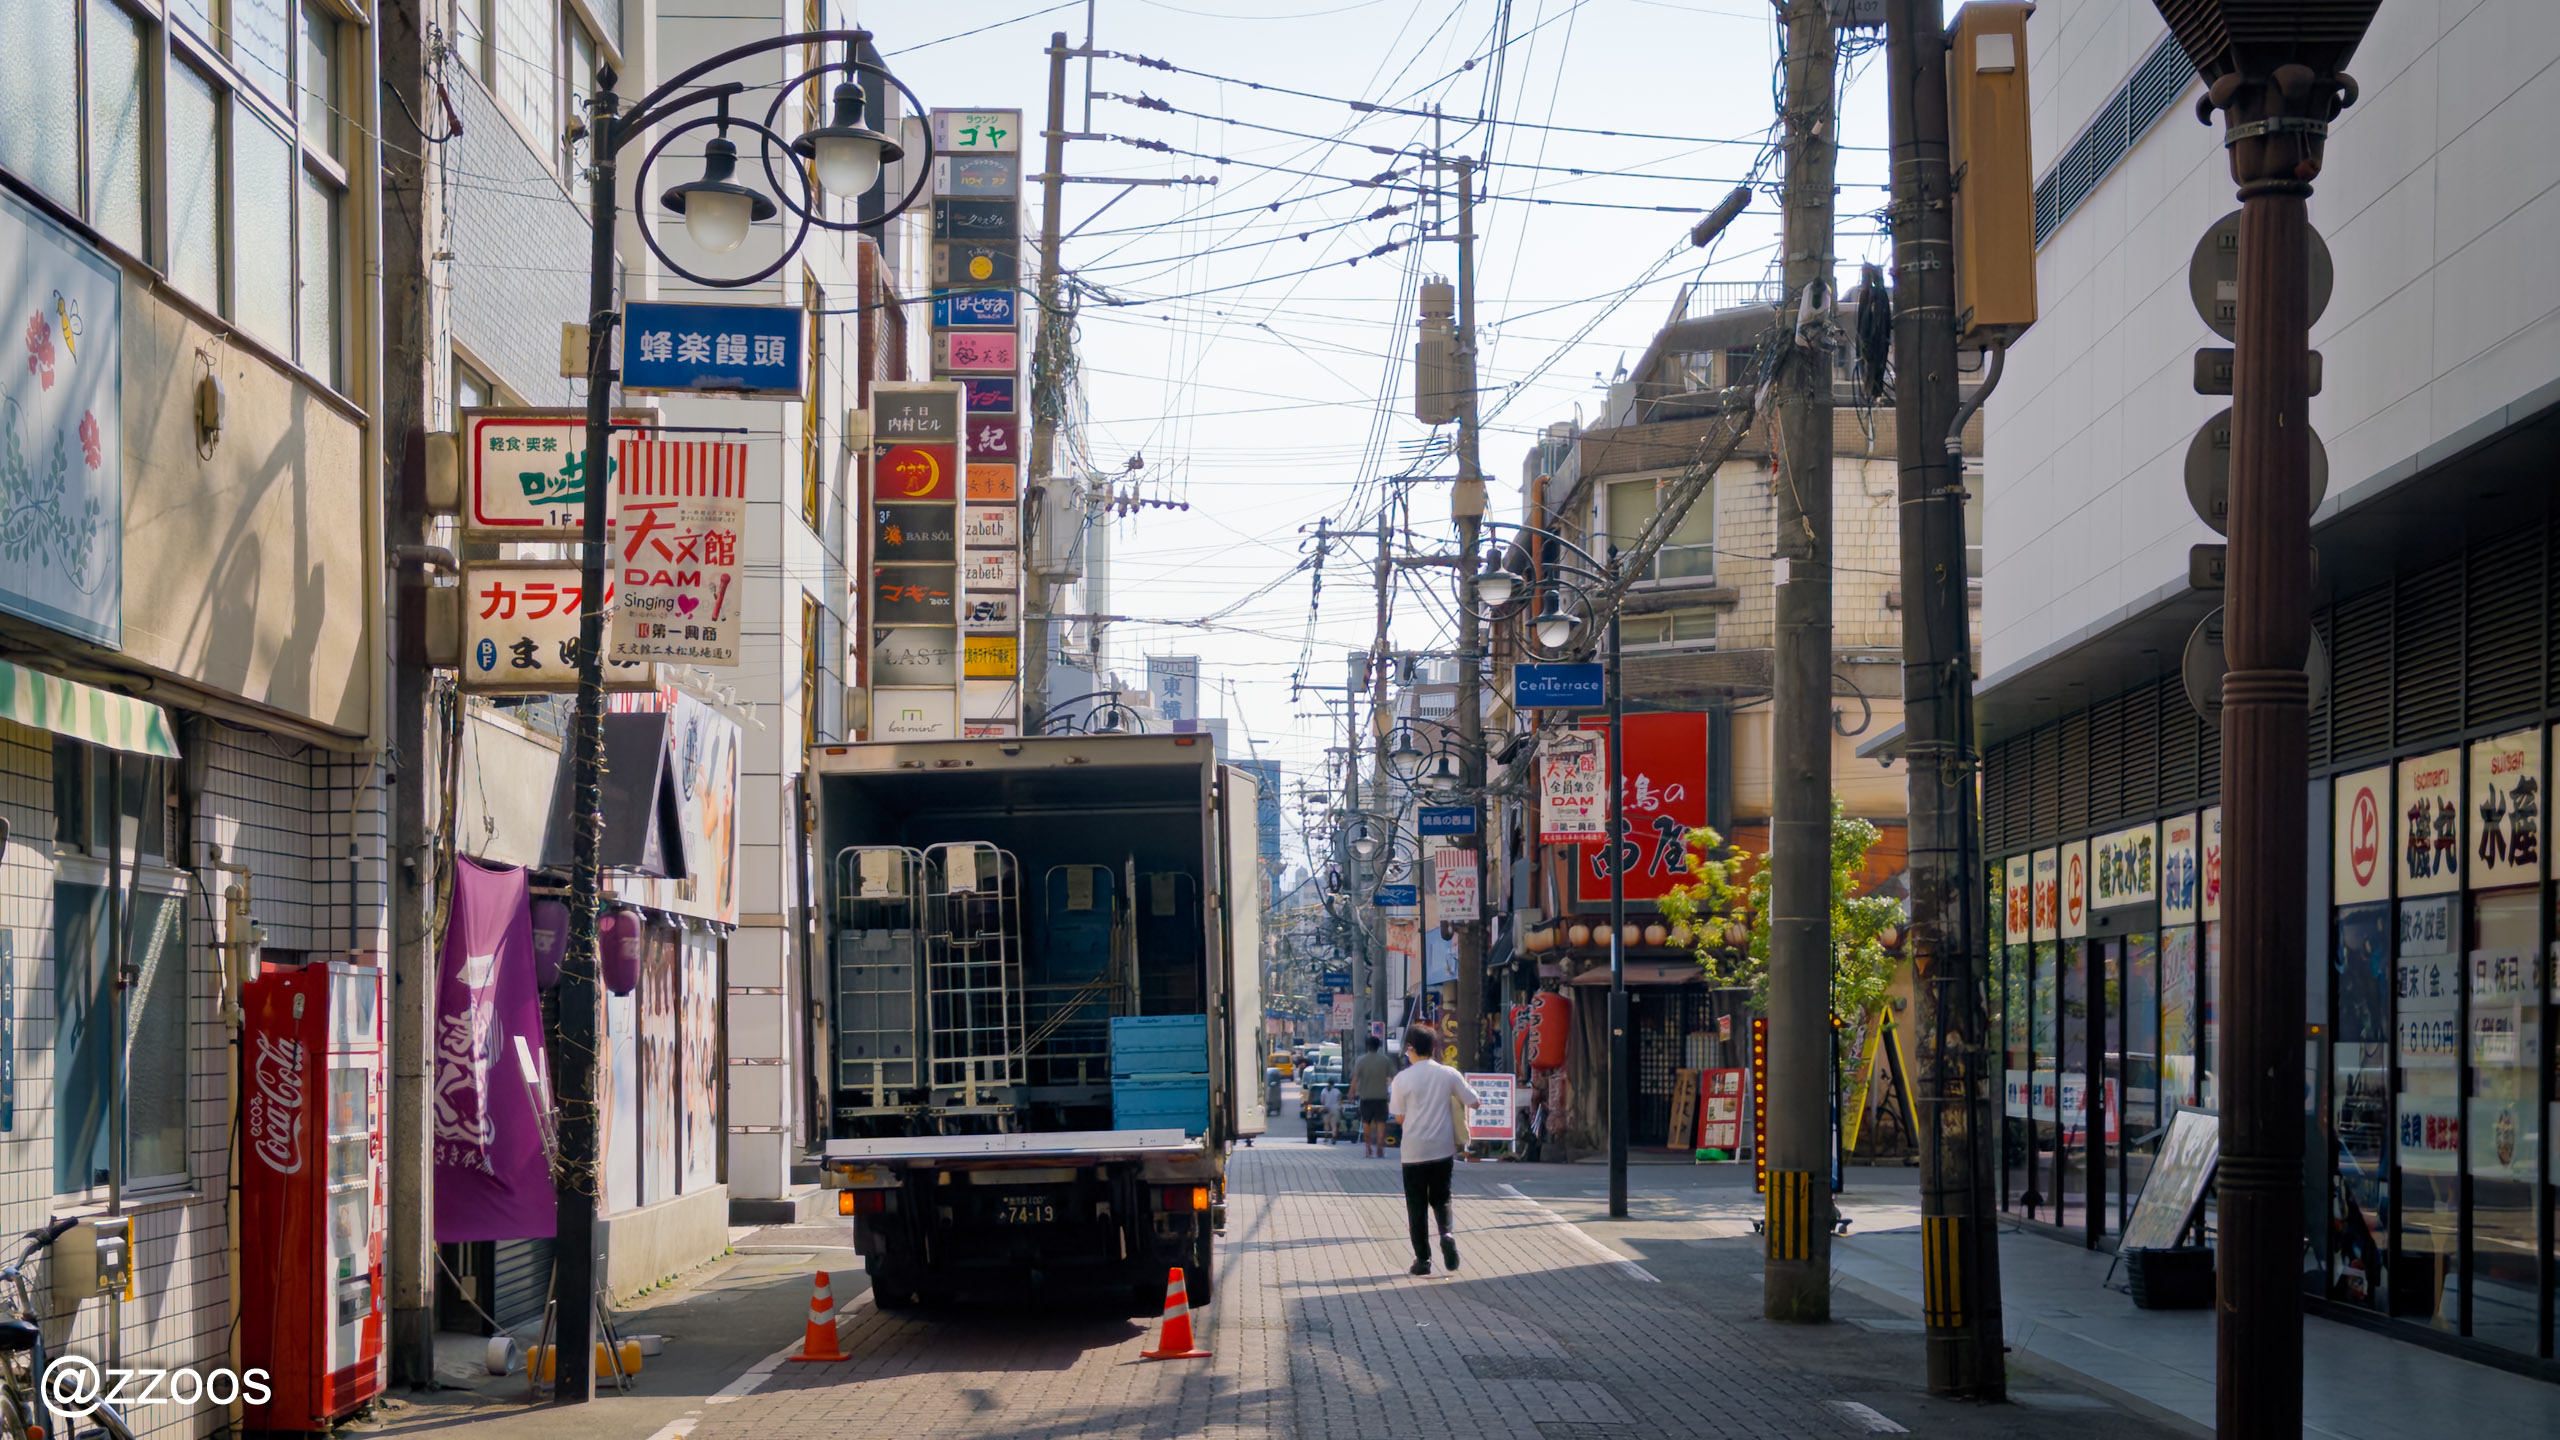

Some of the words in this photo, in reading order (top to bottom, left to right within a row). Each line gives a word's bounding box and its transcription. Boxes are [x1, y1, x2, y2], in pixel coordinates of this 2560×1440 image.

[958, 124, 1007, 149] ゴヤ
[640, 330, 786, 367] 蜂楽饅頭
[903, 406, 928, 416] 千日
[888, 418, 941, 432] 内村ビル
[550, 510, 572, 526] 1F
[880, 510, 890, 523] 3F
[624, 502, 737, 567] 天文館
[906, 532, 930, 541] BAR
[966, 521, 1003, 536] zabeth
[624, 568, 701, 587] DAM
[966, 564, 1003, 580] zabeth
[624, 591, 675, 613] Singing
[653, 623, 717, 641] 第一興商
[884, 648, 949, 665] LAST
[1151, 662, 1193, 673] HOTEL
[1547, 755, 1595, 779] 天文館
[2414, 767, 2449, 791] isomaru
[2491, 750, 2525, 775] suisan
[1552, 797, 1594, 806] DAM
[2407, 795, 2457, 879] 磯丸
[2478, 775, 2538, 870] 水産
[2099, 832, 2152, 899] 磯丸水産
[2400, 906, 2446, 943] 飲み放題
[255, 1028, 303, 1175] Coca-Cola
[1009, 1205, 1054, 1223] 74-19
